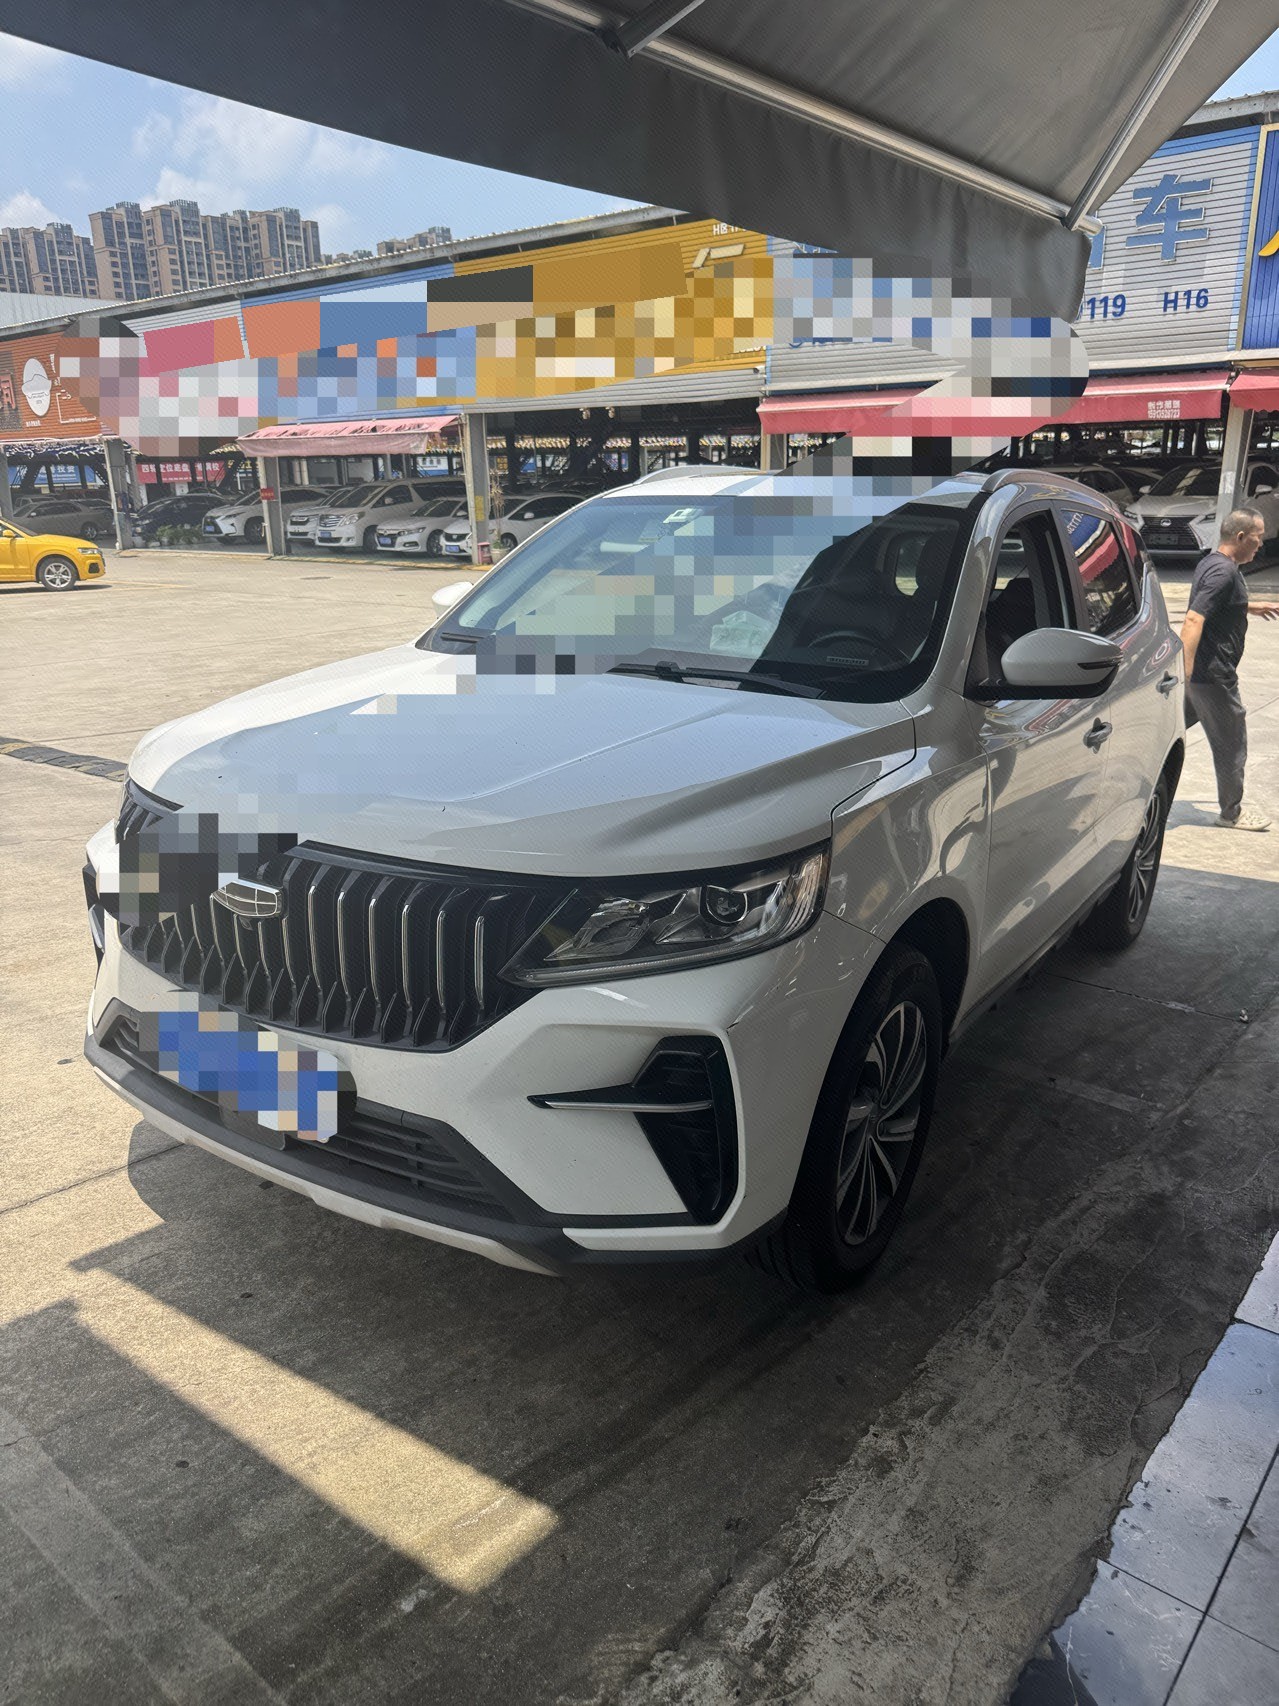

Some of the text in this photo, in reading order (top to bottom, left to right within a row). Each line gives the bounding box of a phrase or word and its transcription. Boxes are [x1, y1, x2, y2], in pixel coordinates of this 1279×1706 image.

[1088, 174, 1214, 270] 车
[1077, 288, 1209, 320] 119 H16
